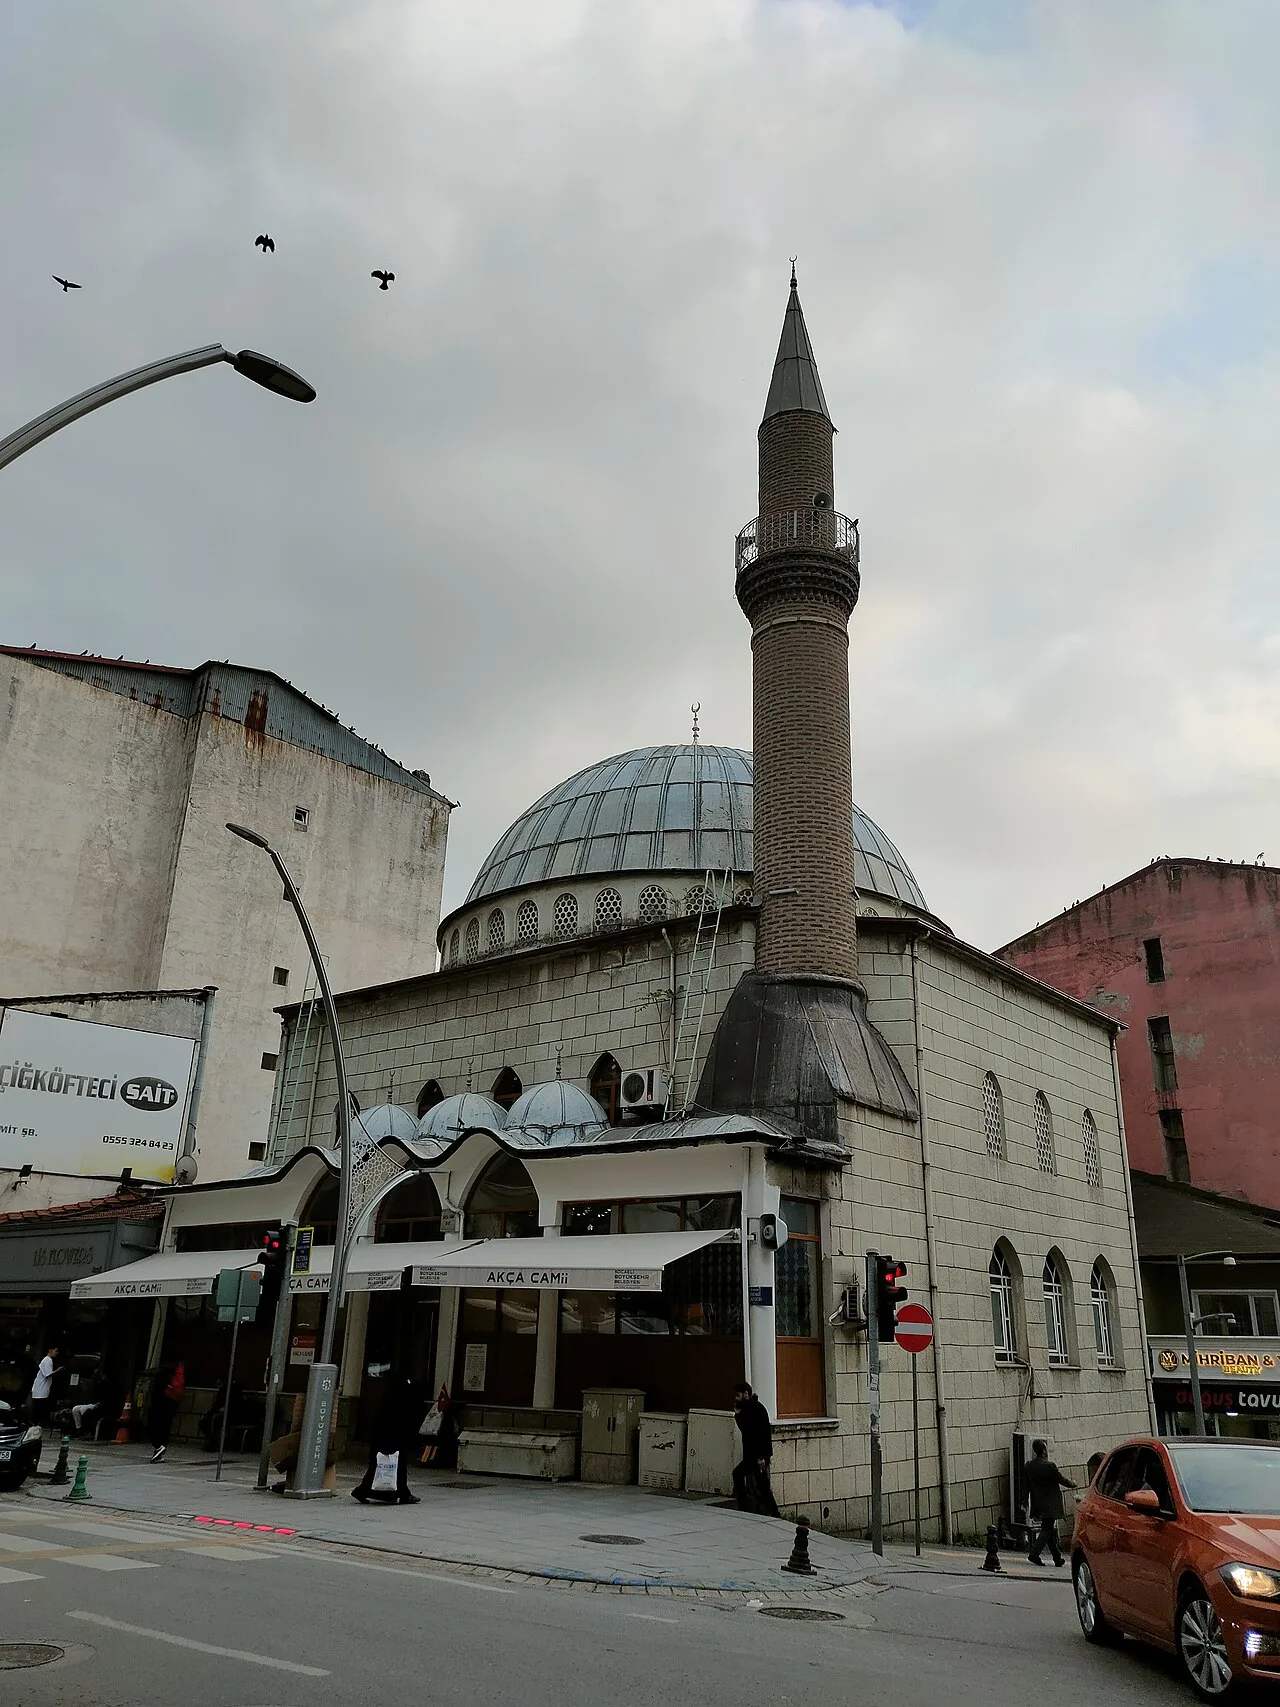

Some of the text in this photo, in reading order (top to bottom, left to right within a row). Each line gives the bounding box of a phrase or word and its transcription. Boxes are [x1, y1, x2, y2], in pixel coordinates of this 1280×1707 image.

[126, 1083, 174, 1105] SAİT
[102, 1135, 174, 1151] 0555 324 84 23
[288, 1278, 303, 1290] ÇA
[487, 1271, 524, 1286] AKÇA
[114, 1285, 136, 1295] AKÇA
[1263, 1355, 1274, 1366] &
[1223, 1365, 1262, 1375] BEAUTY
